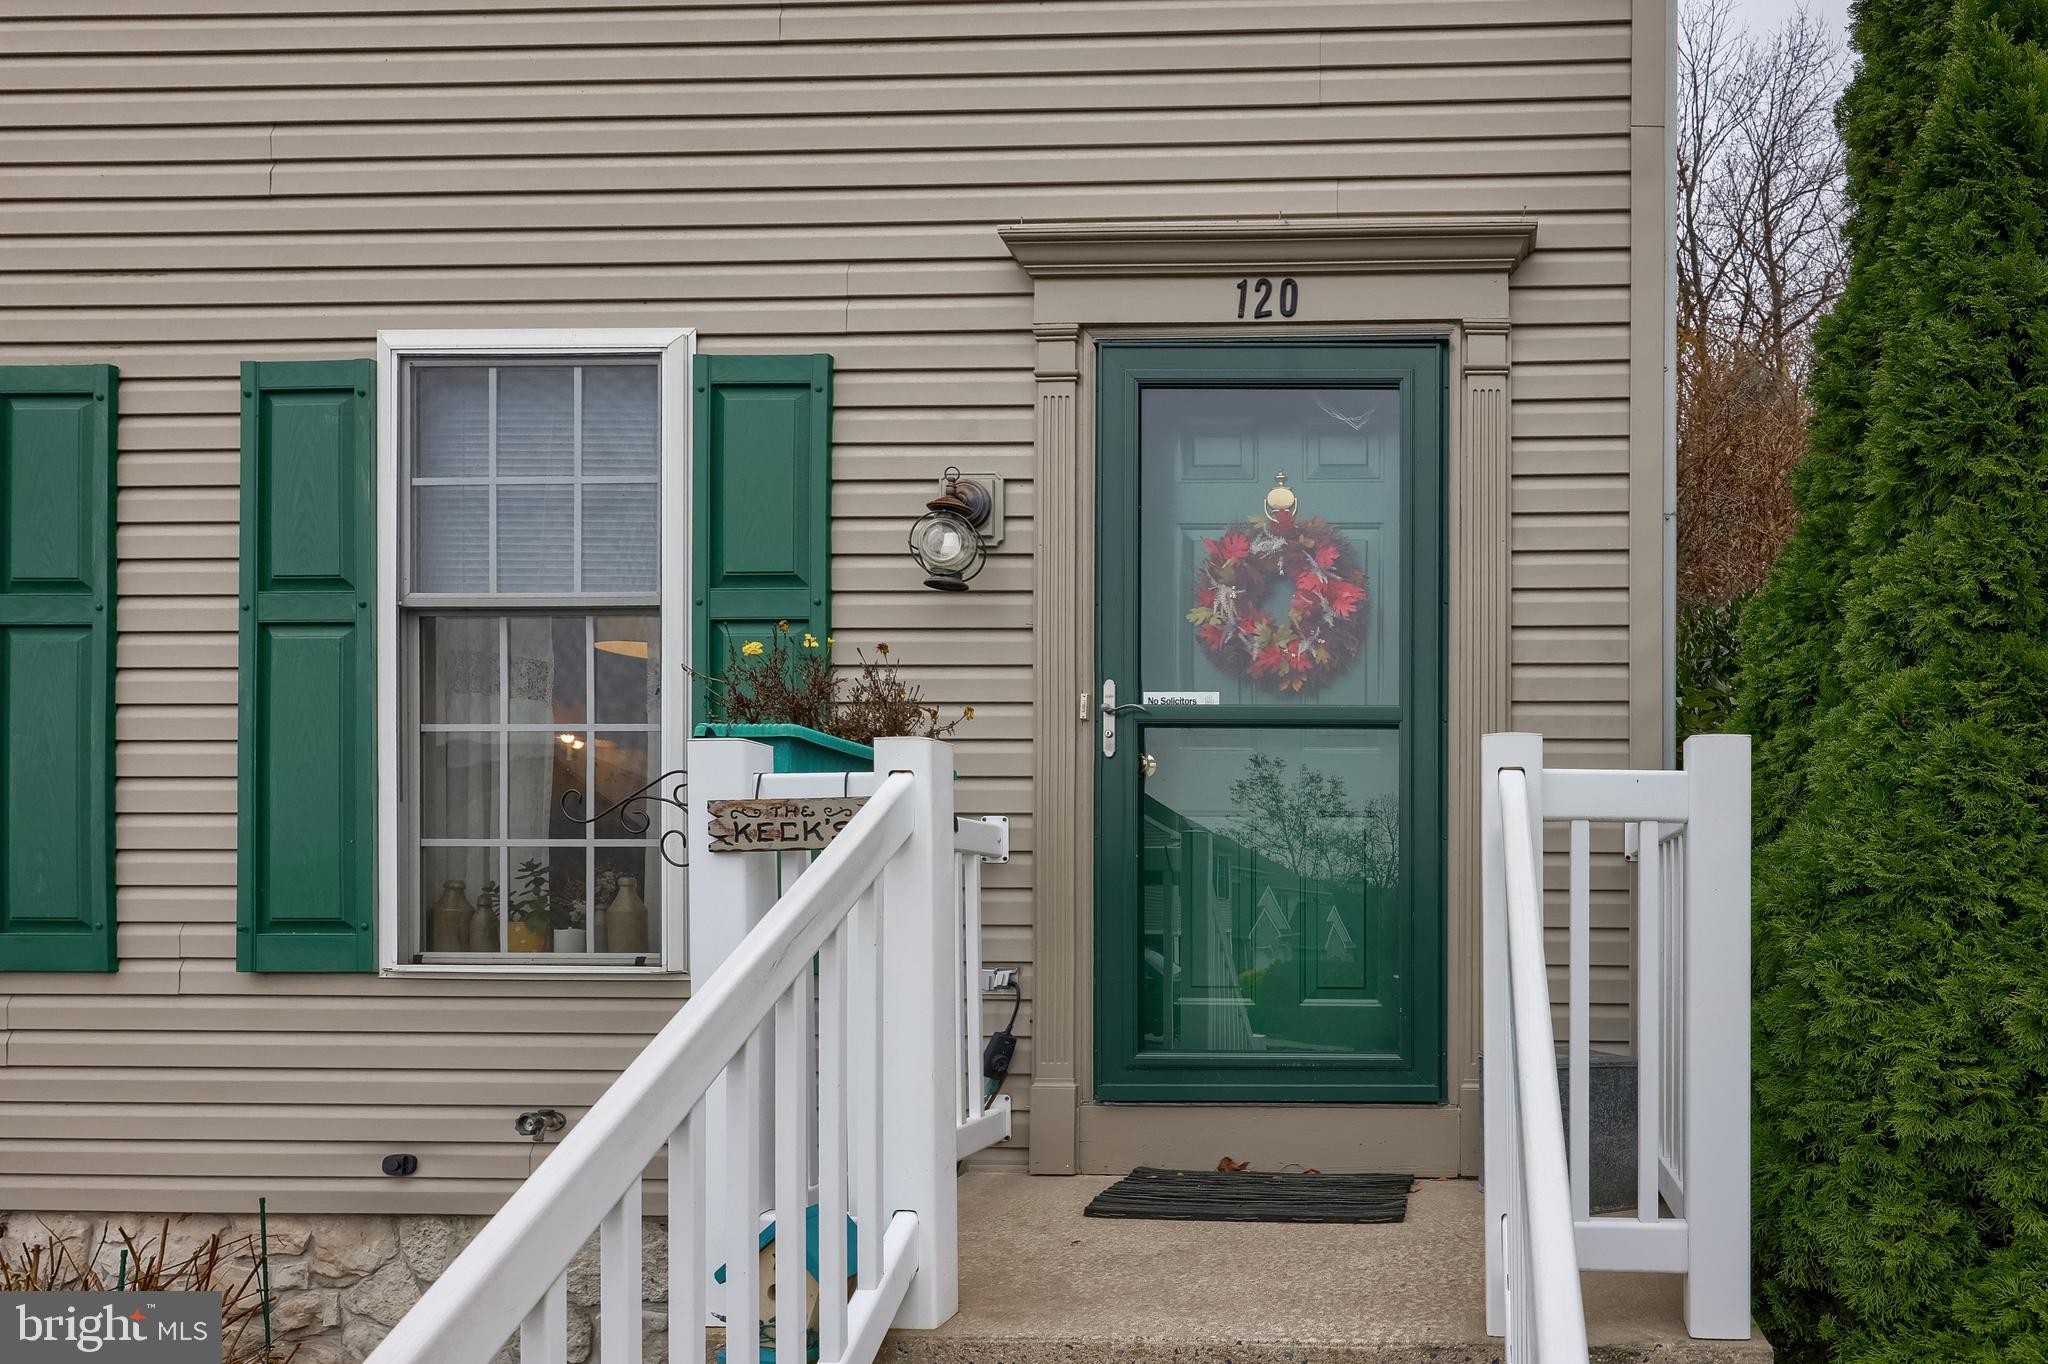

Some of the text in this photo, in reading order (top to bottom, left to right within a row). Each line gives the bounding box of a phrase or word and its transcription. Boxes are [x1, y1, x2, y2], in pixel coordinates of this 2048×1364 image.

[1237, 278, 1298, 319] 120
[1148, 697, 1198, 705] No Solicitors
[770, 805, 815, 818] THE
